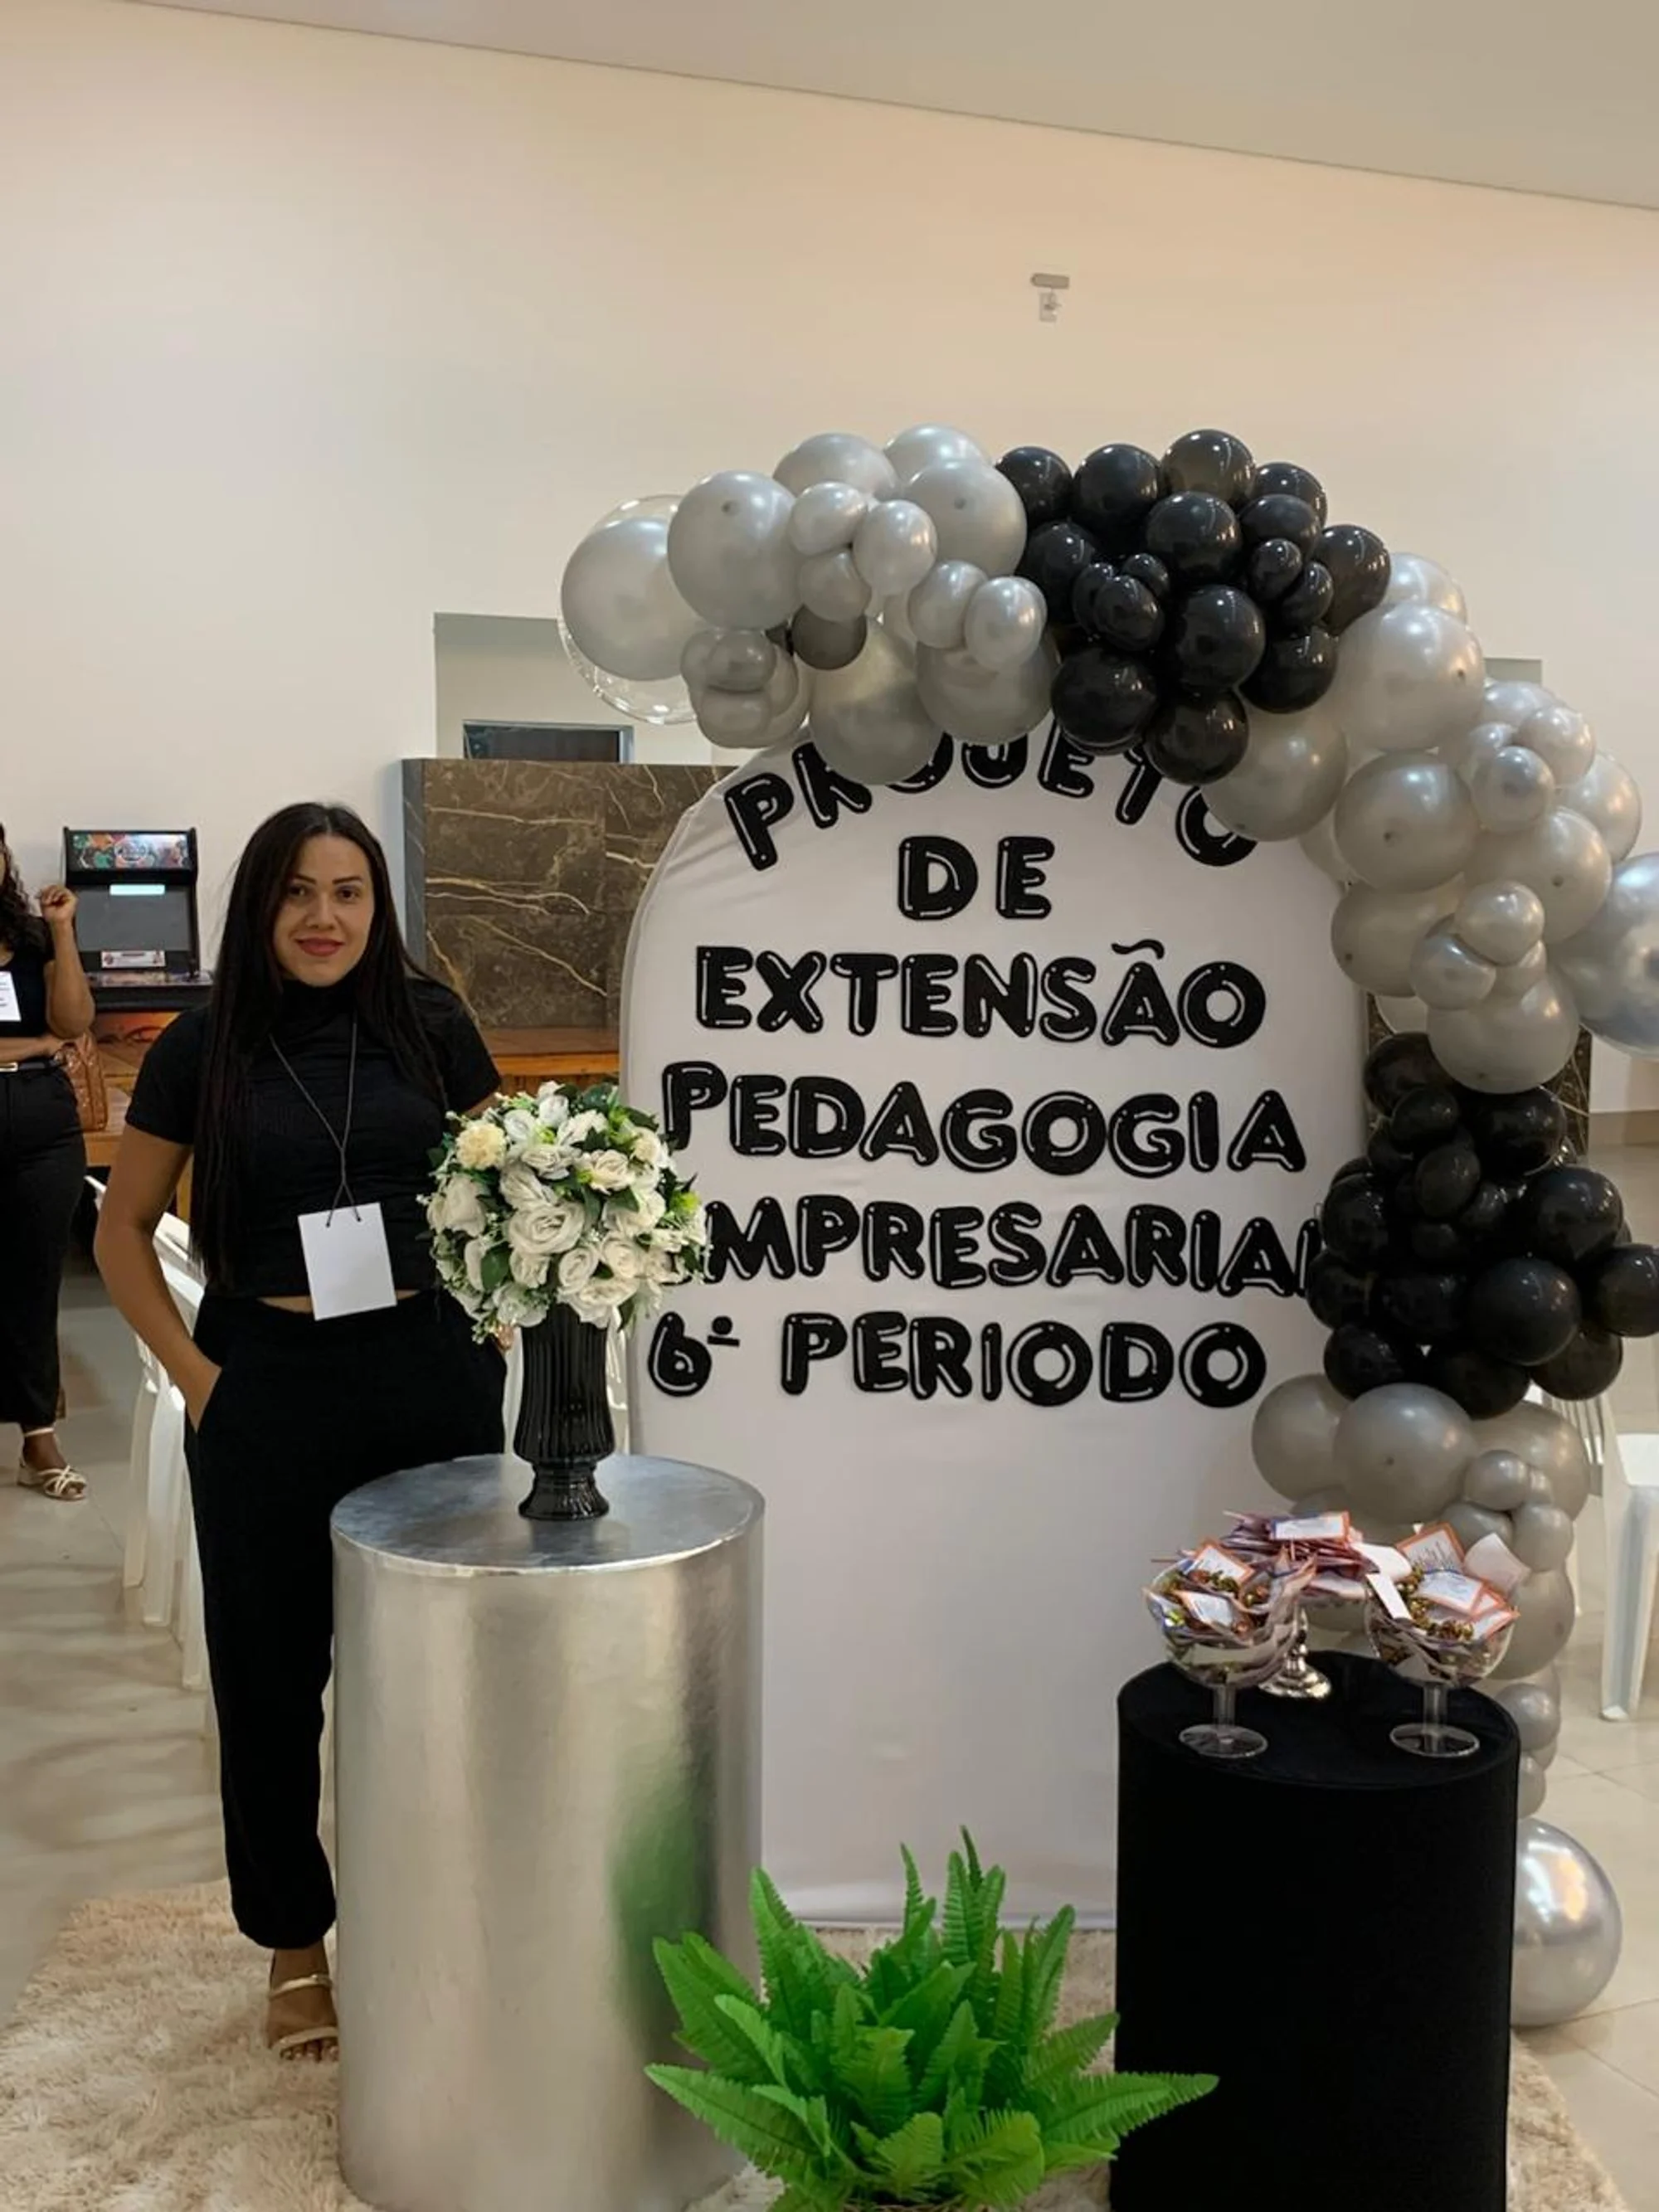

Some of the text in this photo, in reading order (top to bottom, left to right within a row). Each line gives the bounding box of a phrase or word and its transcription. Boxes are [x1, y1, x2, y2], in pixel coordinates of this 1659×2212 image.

[897, 835, 1055, 921] DE
[696, 938, 1267, 1049] EXTENSÃO
[662, 1061, 1308, 1179] PEDAGOGIA
[781, 1310, 1267, 1408] PERIODO
